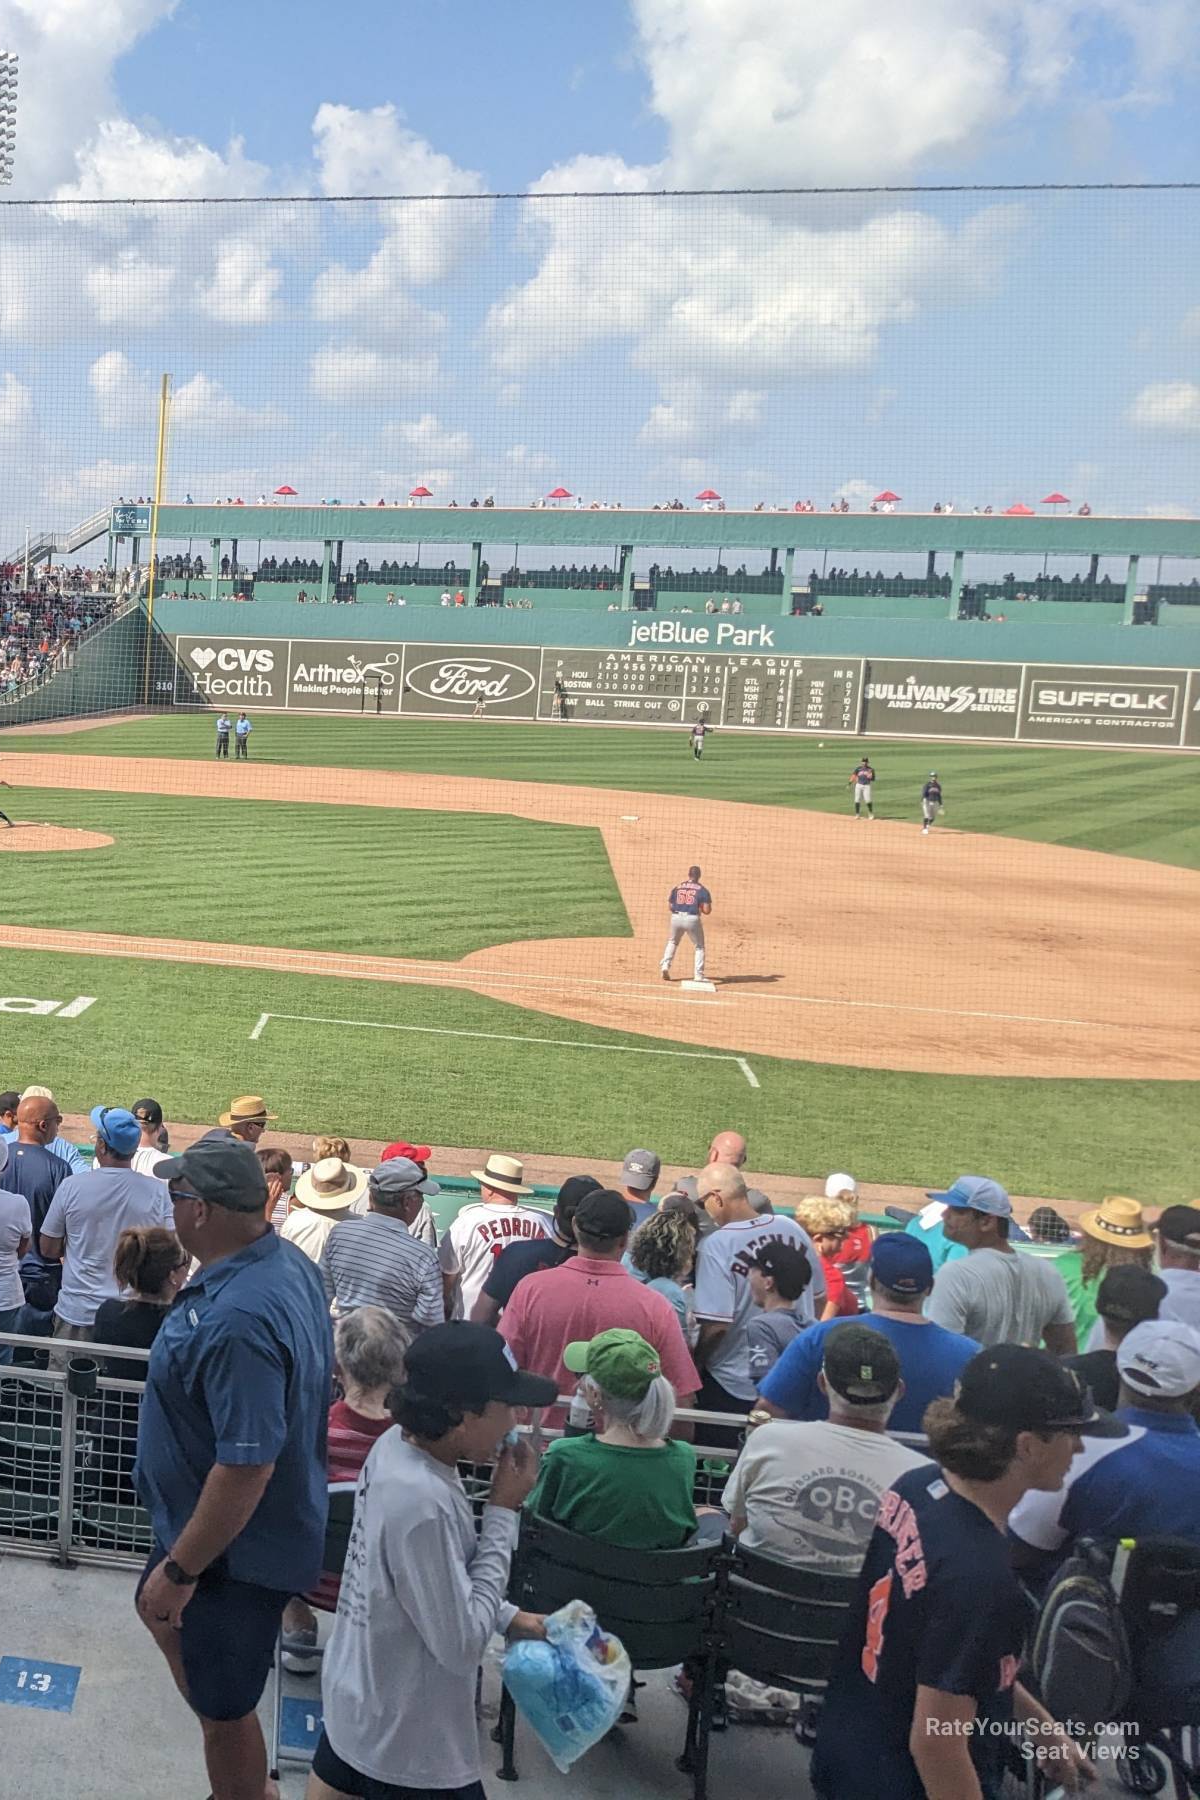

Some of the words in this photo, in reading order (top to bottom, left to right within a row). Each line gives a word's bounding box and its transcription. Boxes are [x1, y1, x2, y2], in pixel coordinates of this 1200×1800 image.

[628, 620, 709, 647] jetBlue
[717, 623, 775, 647] Park
[217, 649, 274, 672] CVS
[606, 662, 611, 670] 2
[613, 662, 618, 670] 3
[624, 663, 629, 671] 4
[632, 663, 638, 671] 5
[658, 664, 664, 672] 8
[666, 664, 672, 672] 9
[607, 653, 706, 664] AMERICAN
[728, 657, 802, 668] LEAGUE
[293, 661, 367, 684] Arthrex
[430, 664, 510, 697] Ford
[767, 668, 776, 676] IN
[780, 668, 785, 676] R
[796, 669, 803, 677] P
[834, 670, 843, 678] IN
[846, 670, 853, 678] R
[156, 681, 173, 691] 310
[192, 672, 273, 697] Health
[293, 683, 327, 695] Making
[329, 684, 361, 696] People
[810, 688, 823, 696] ATL
[744, 693, 758, 701] TOR
[864, 683, 951, 702] SULLIVAN
[978, 687, 1018, 704] TIRE
[1038, 690, 1168, 710] SUFFOLK
[614, 700, 640, 708] STRIKE
[888, 700, 912, 709] AND
[914, 702, 946, 710] AUTO
[970, 704, 1016, 712] SERVICE
[1028, 716, 1092, 725] AMERICA'S
[1096, 718, 1175, 728] CONTRACTOR
[477, 1217, 545, 1243] PEDROIA
[839, 1467, 886, 1493] BOATIN
[809, 1485, 876, 1519] OBC
[16, 1671, 52, 1692] 13
